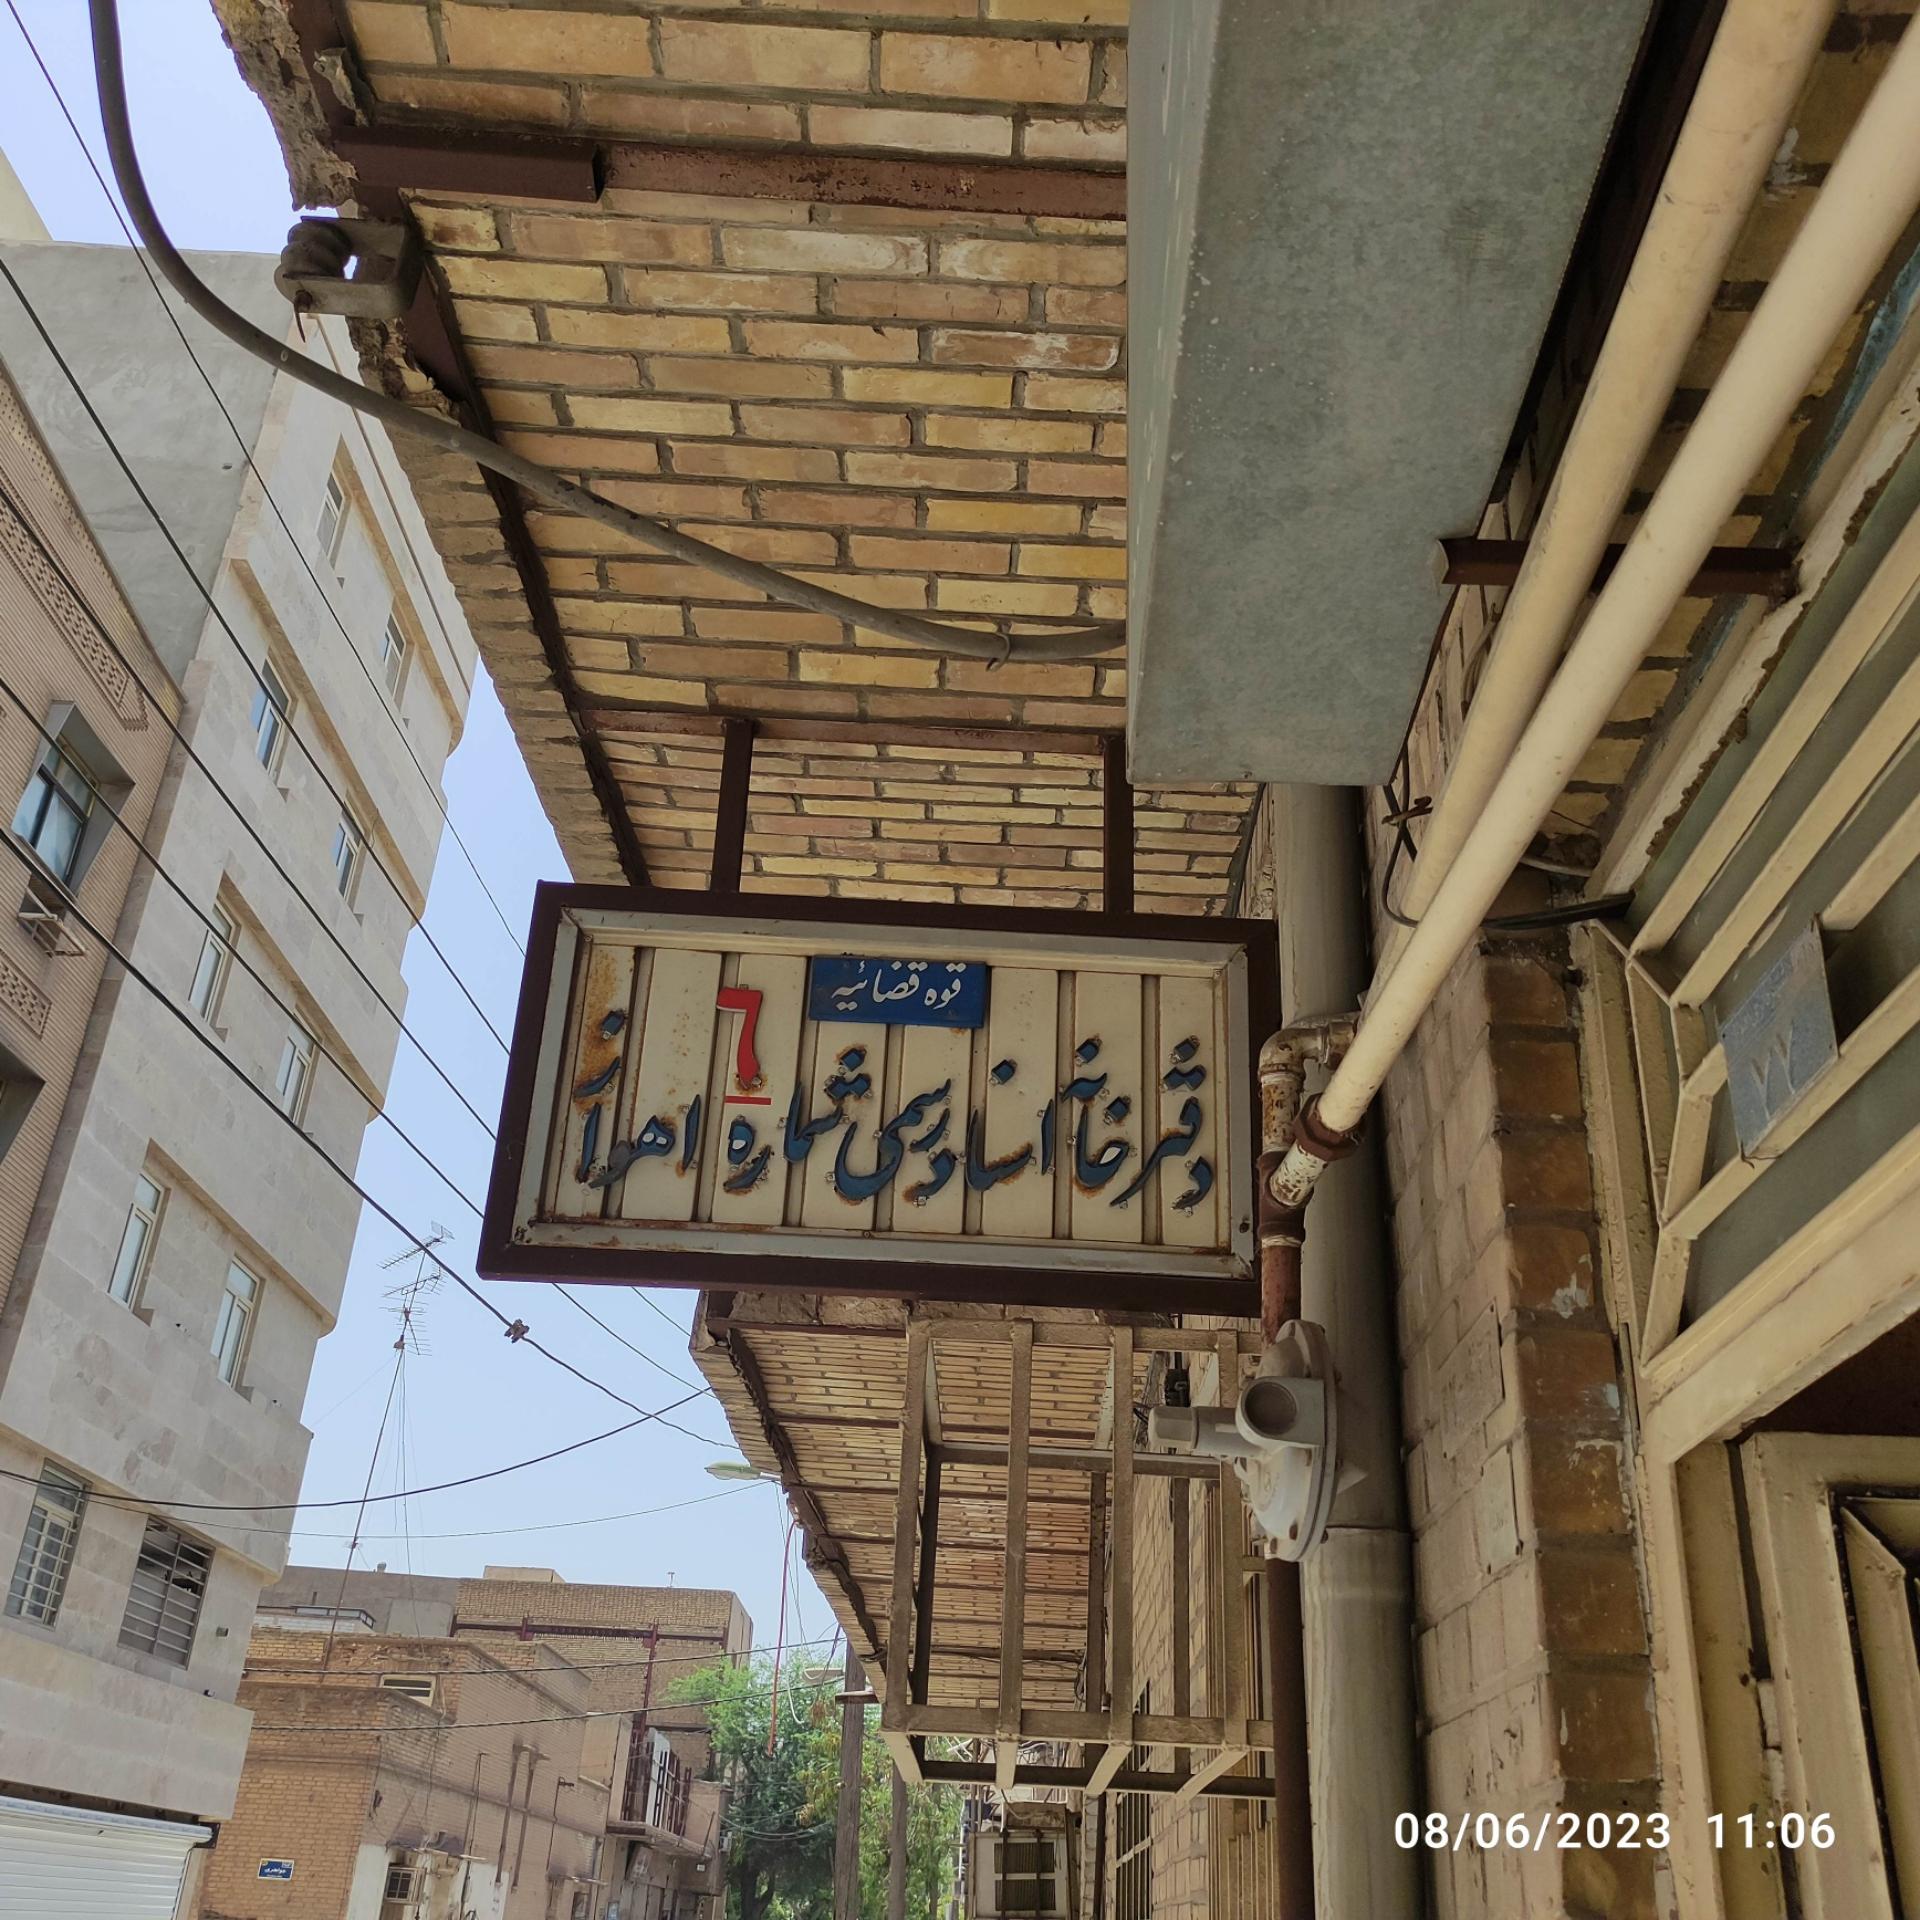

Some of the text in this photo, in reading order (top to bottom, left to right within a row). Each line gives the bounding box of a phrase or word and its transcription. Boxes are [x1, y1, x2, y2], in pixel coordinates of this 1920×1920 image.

[924, 961, 967, 1011] قوه
[572, 1007, 702, 1188] اهواز
[721, 1047, 873, 1193] شماره
[834, 1078, 953, 1202] رسمی
[906, 1058, 1057, 1206] اسناد
